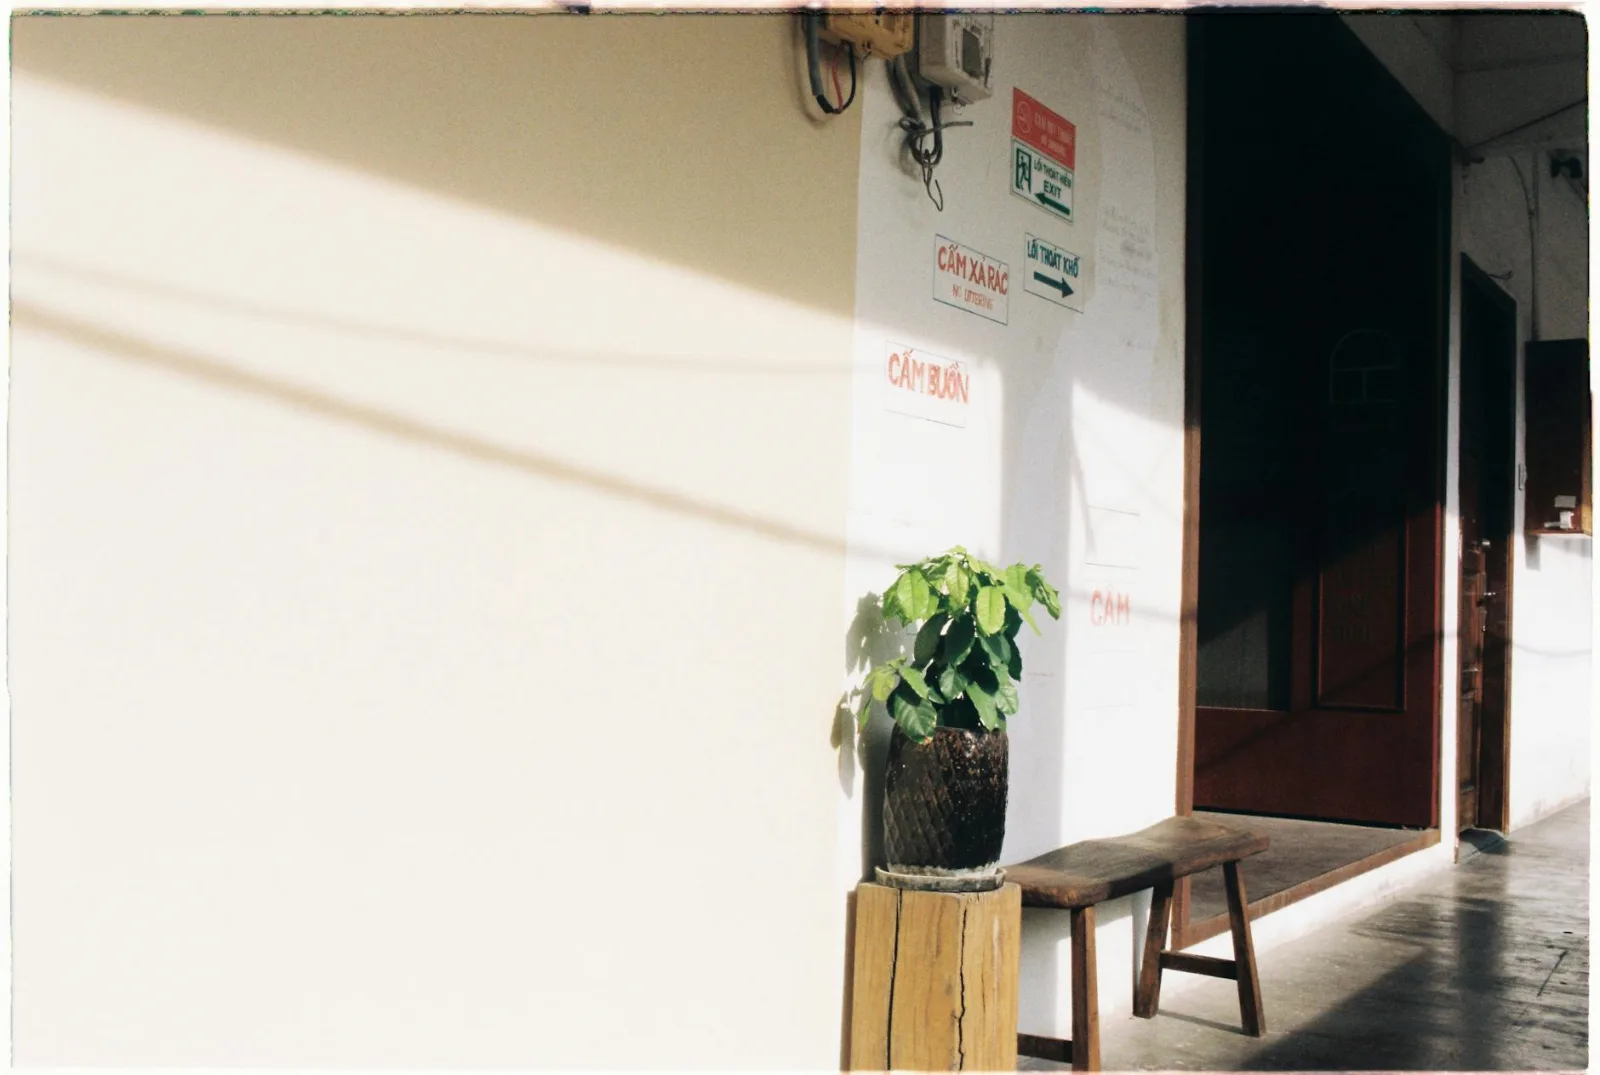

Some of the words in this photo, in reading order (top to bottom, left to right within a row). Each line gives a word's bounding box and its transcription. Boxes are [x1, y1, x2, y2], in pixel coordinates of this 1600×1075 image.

[1043, 180, 1062, 199] EXIT
[937, 244, 967, 280] CẤM
[968, 256, 986, 287] XẢ
[987, 263, 1009, 296] RÁC
[887, 349, 926, 394] CẤM
[927, 362, 969, 404] BUỒN
